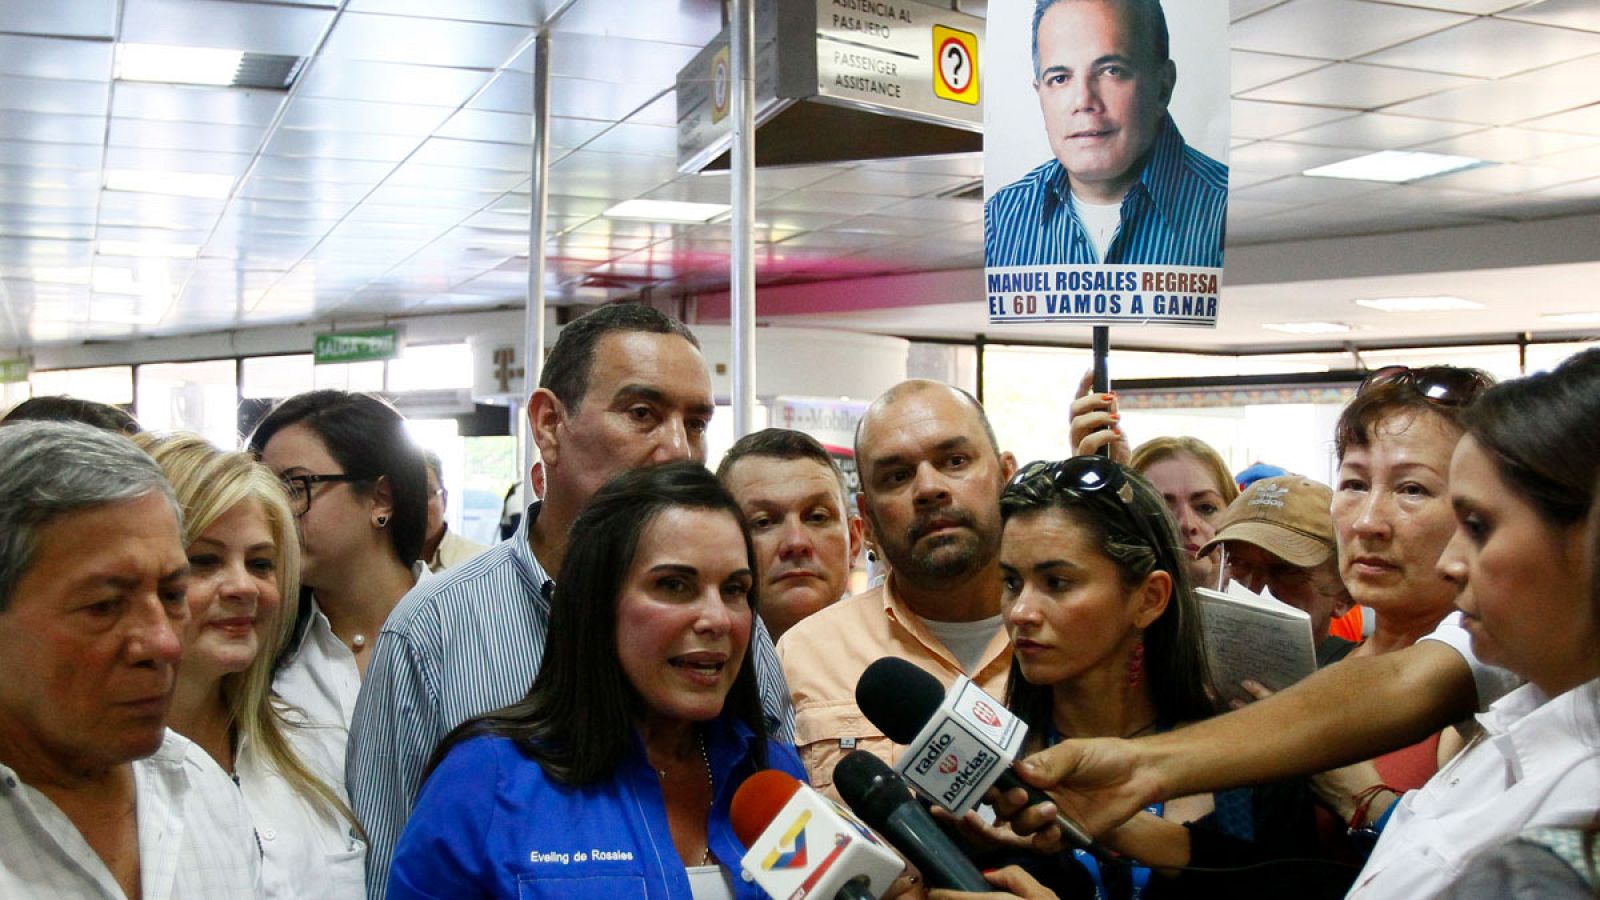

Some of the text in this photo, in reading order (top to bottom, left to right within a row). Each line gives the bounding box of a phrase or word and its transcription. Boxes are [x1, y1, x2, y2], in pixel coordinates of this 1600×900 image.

[833, 13, 890, 39] PASAJERO
[899, 9, 912, 23] AL
[834, 51, 897, 76] PASSENGER
[835, 74, 901, 98] ASSISTANCE
[988, 271, 1217, 294] MANUEL ROSALES REGRESA
[989, 294, 1217, 317] EL 6D VAMOS A GANAR
[914, 733, 952, 775] radio
[942, 750, 988, 803] noticias
[530, 849, 634, 865] Eveling de Rosales
